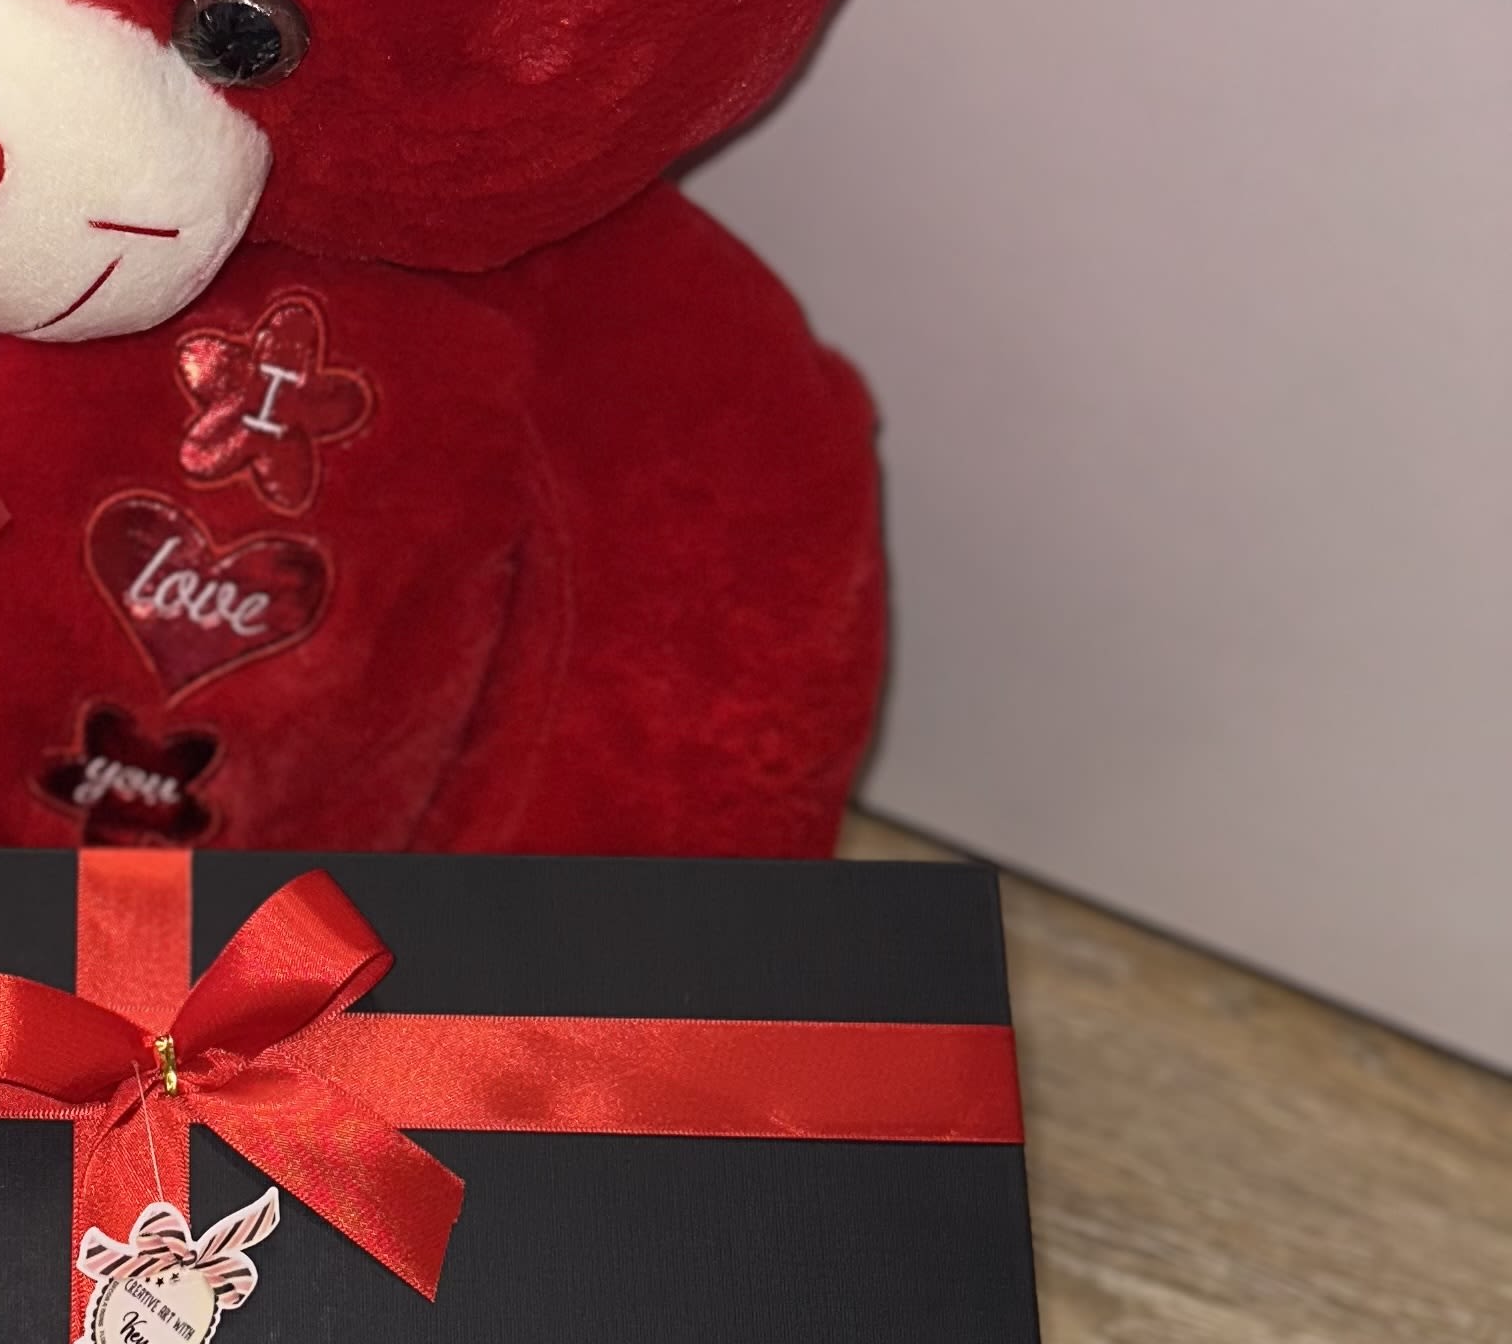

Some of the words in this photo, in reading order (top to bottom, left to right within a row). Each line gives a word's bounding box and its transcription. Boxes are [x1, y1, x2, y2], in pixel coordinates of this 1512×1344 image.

[242, 363, 306, 437] I
[73, 756, 181, 805] you
[124, 1278, 161, 1313] CREATIVE
[157, 1305, 176, 1324] ART
[172, 1317, 195, 1341] WITH
